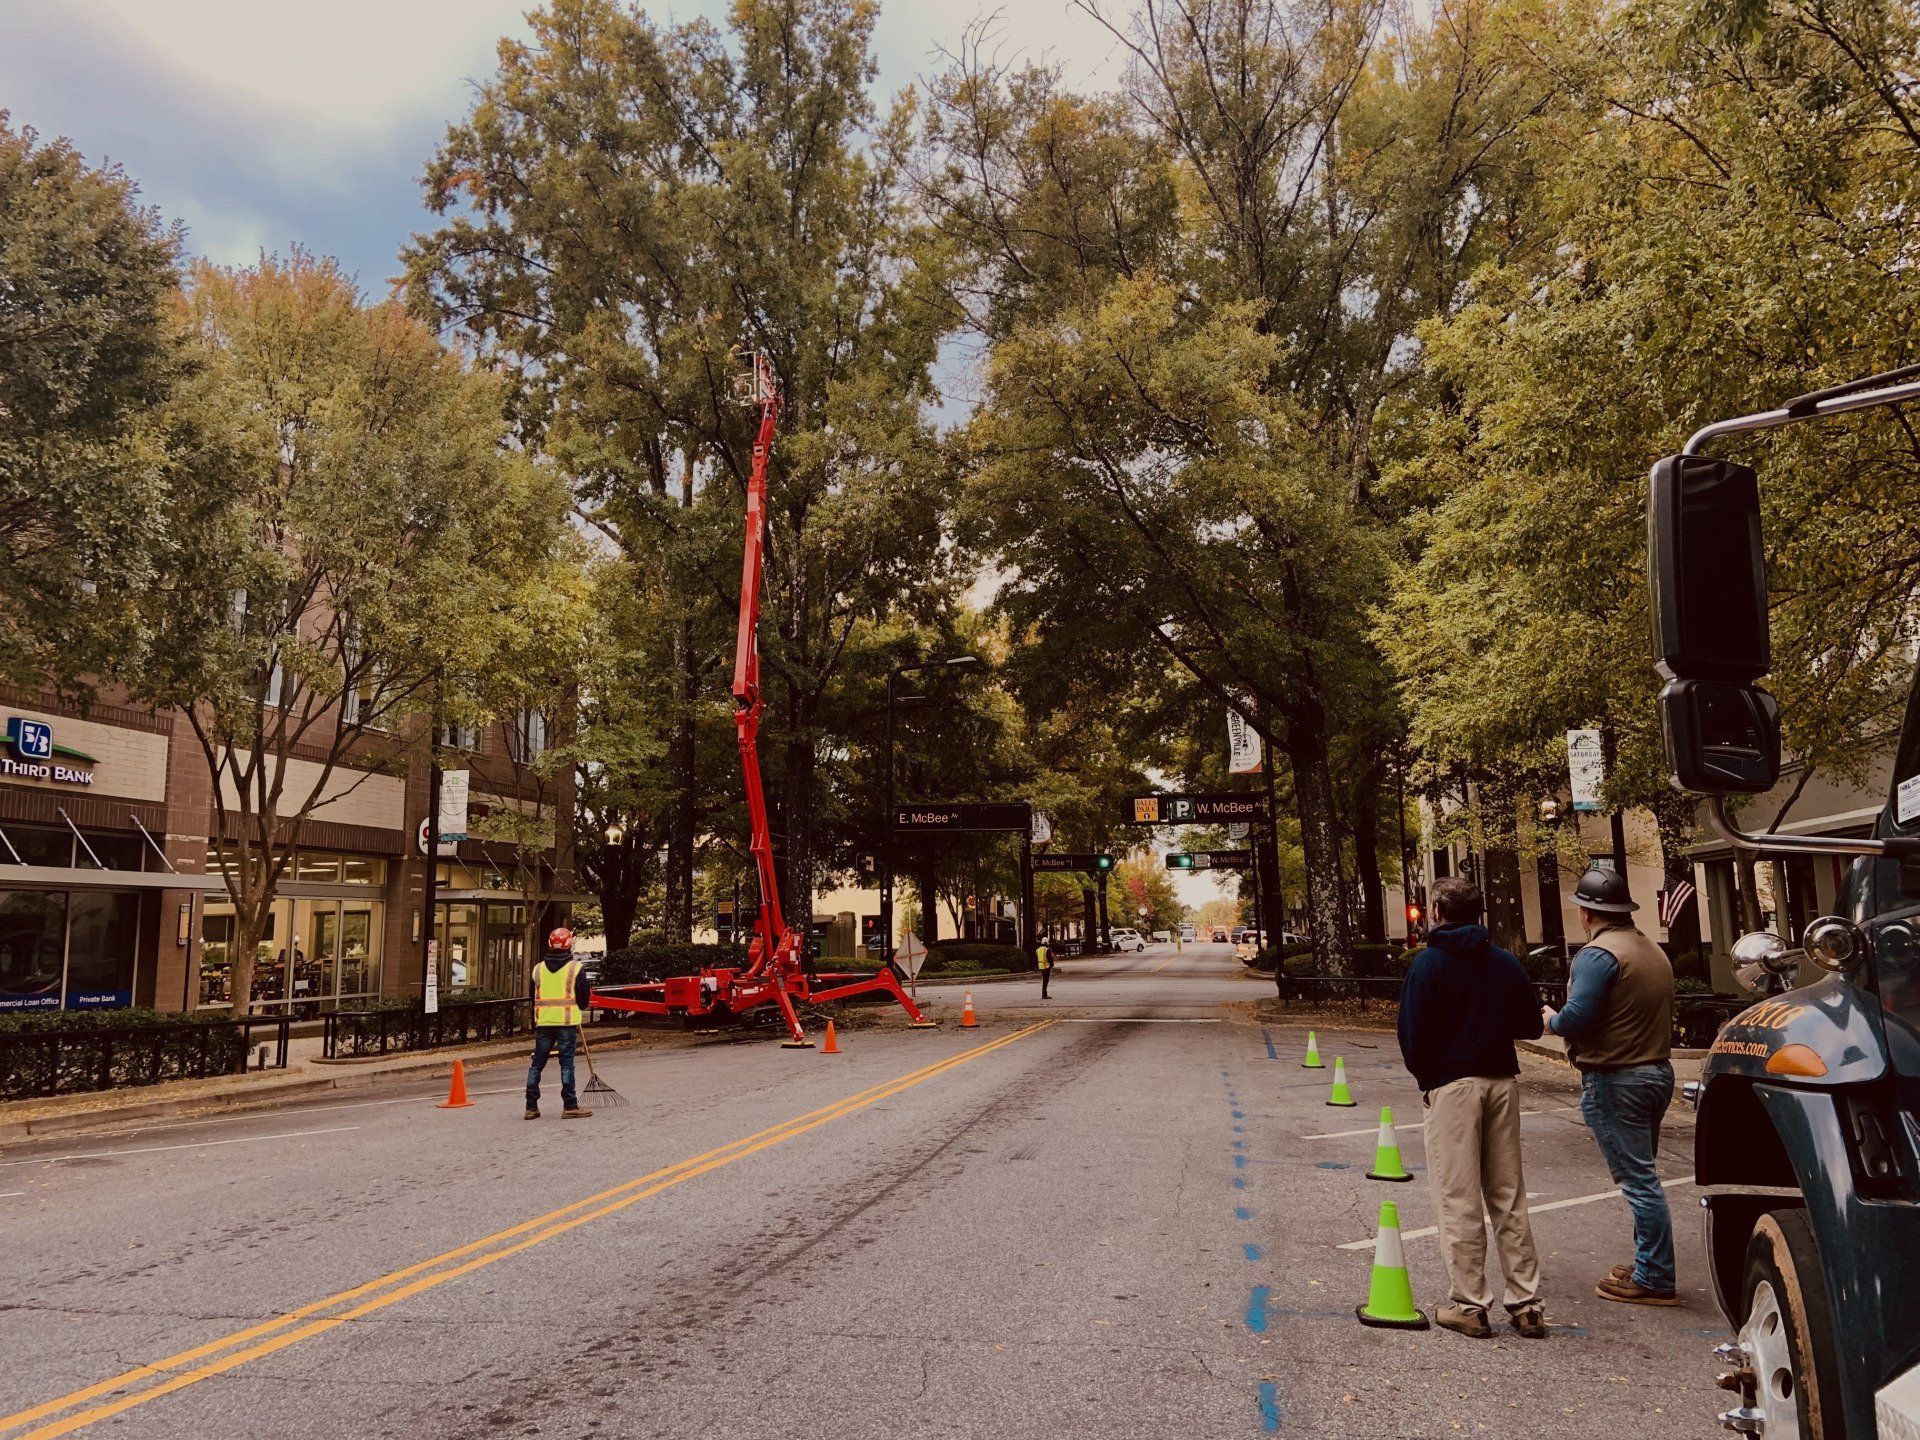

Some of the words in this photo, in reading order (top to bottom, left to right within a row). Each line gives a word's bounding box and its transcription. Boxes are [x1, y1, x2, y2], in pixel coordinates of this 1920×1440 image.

[1, 758, 50, 778] THIRD
[54, 766, 94, 784] BANK
[1197, 803, 1210, 813] W.
[1212, 802, 1253, 813] McBee
[899, 813, 909, 824] E.
[911, 812, 949, 824] McBee
[41, 997, 60, 1005] Office
[101, 994, 116, 1003] Bank
